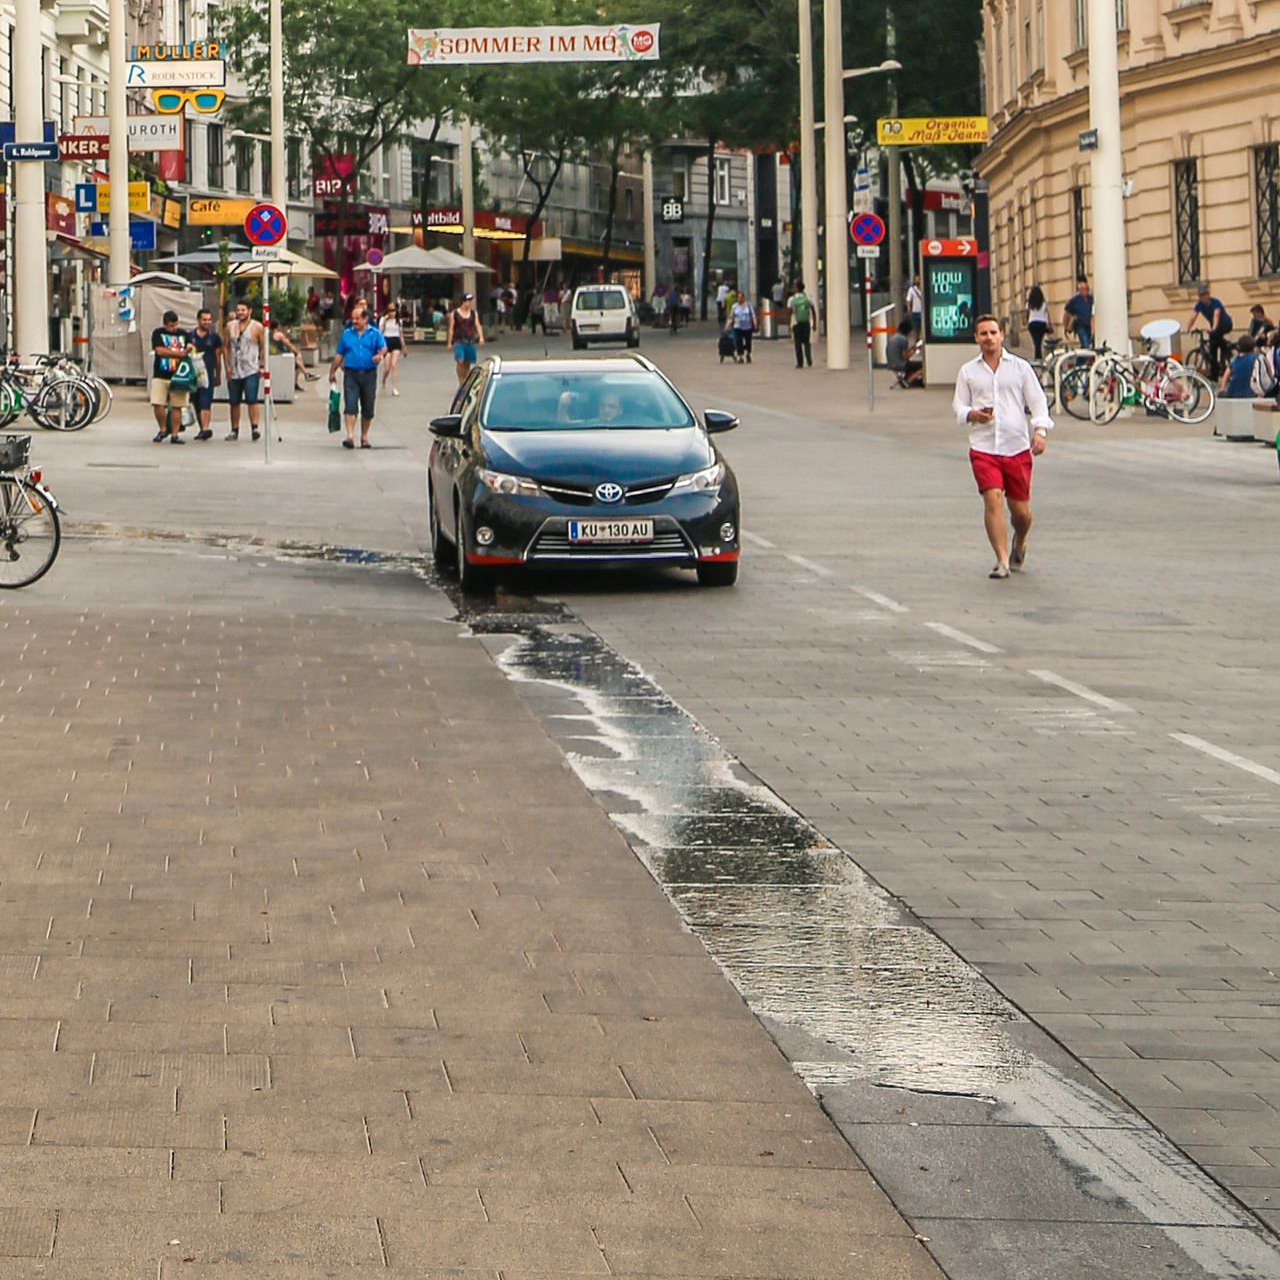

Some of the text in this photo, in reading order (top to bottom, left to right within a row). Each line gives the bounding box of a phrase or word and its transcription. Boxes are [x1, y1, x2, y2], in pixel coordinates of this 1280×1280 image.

[137, 42, 220, 60] MÜLLER
[440, 34, 617, 54] SOMMER IM MQ
[151, 71, 217, 82] RODENSTOCK
[926, 119, 977, 133] Organic
[190, 200, 221, 213] Café
[932, 271, 962, 285] HOW
[581, 524, 648, 537] KU 130 AU
